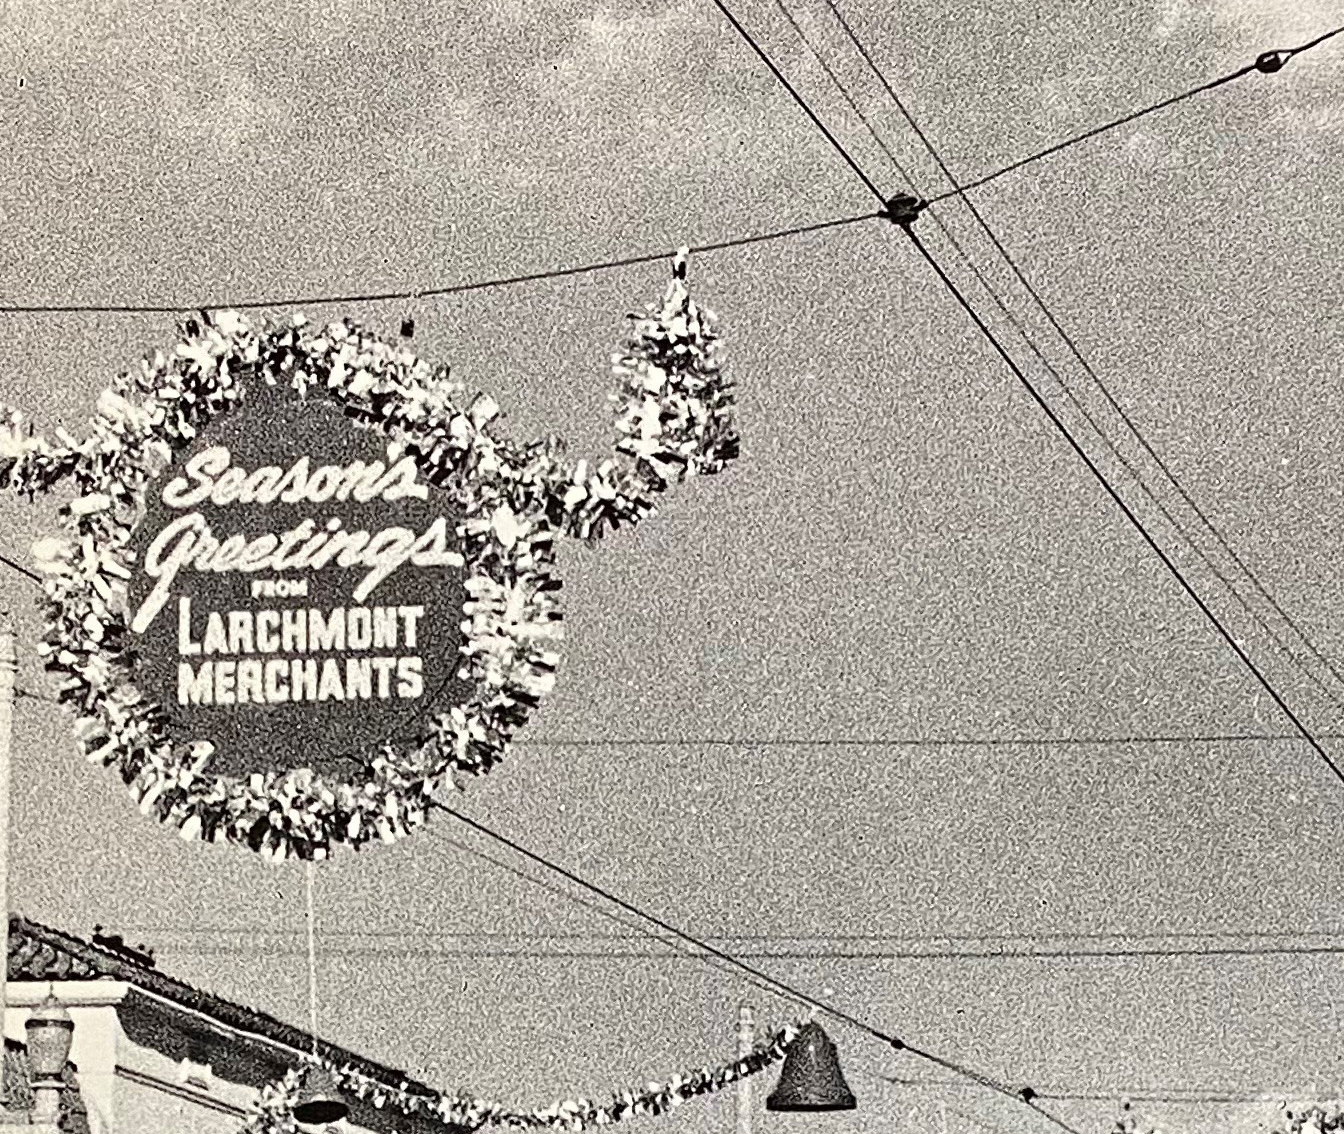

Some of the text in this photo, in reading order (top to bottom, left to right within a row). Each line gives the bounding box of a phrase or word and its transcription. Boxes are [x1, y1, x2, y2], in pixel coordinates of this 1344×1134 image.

[132, 511, 464, 634] Greetings
[252, 580, 307, 597] FROM
[178, 596, 425, 655] LARCHMONT
[177, 656, 423, 706] MERCHANTS
